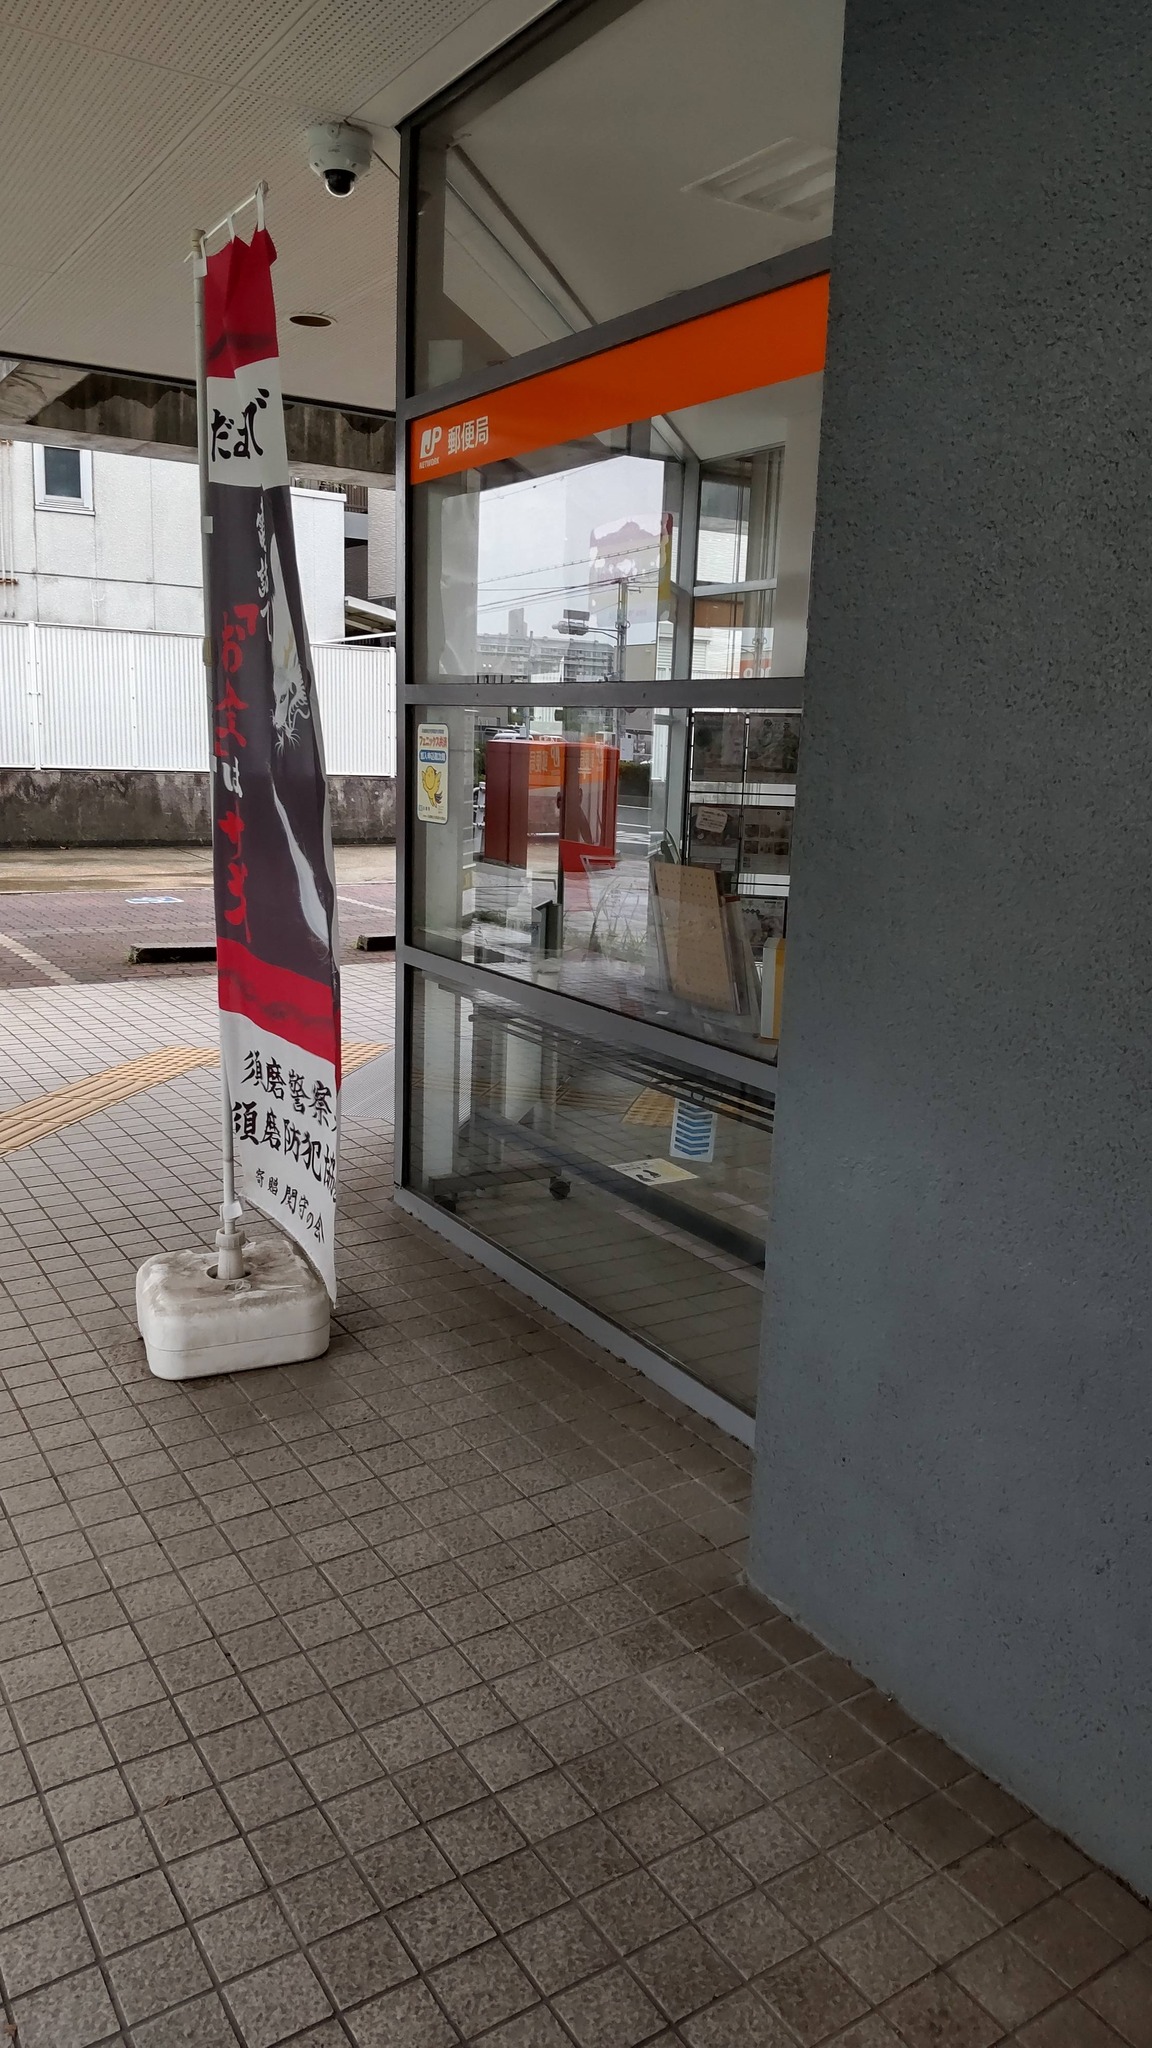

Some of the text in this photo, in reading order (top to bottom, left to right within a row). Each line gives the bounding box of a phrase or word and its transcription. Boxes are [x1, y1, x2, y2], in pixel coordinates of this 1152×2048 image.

[447, 415, 489, 456] 郵便局
[418, 456, 440, 470] NETWORK
[241, 1049, 337, 1132] 須磨警察
